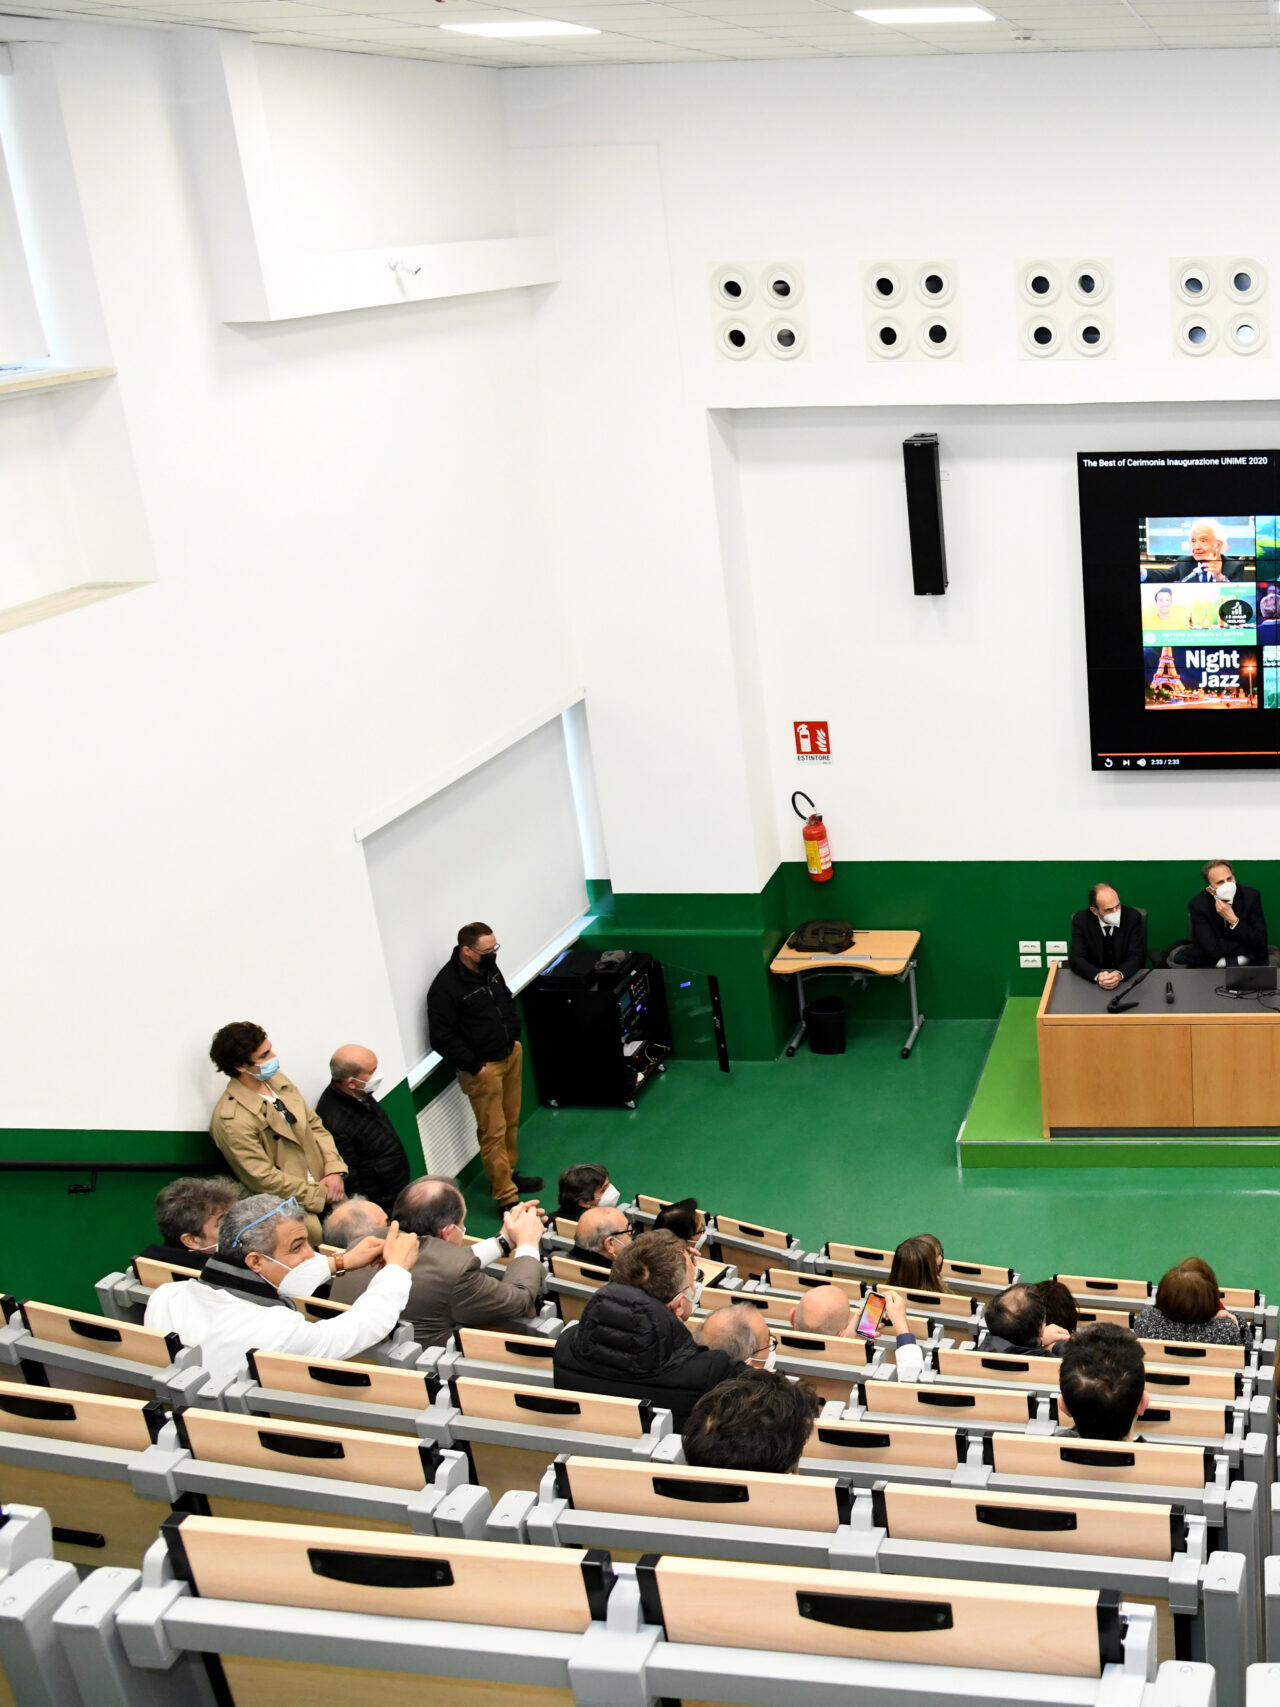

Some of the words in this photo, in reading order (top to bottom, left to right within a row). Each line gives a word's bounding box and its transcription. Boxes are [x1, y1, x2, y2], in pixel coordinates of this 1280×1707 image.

[1082, 458, 1098, 467] The
[1099, 458, 1117, 467] Best
[1117, 458, 1126, 467] of
[1127, 458, 1166, 467] Cerimonia
[1166, 457, 1220, 468] Inaugurazione
[1220, 457, 1247, 465] UNIME
[1248, 456, 1268, 465] 2020
[1185, 649, 1240, 673] Night
[1198, 671, 1240, 688] Jazz
